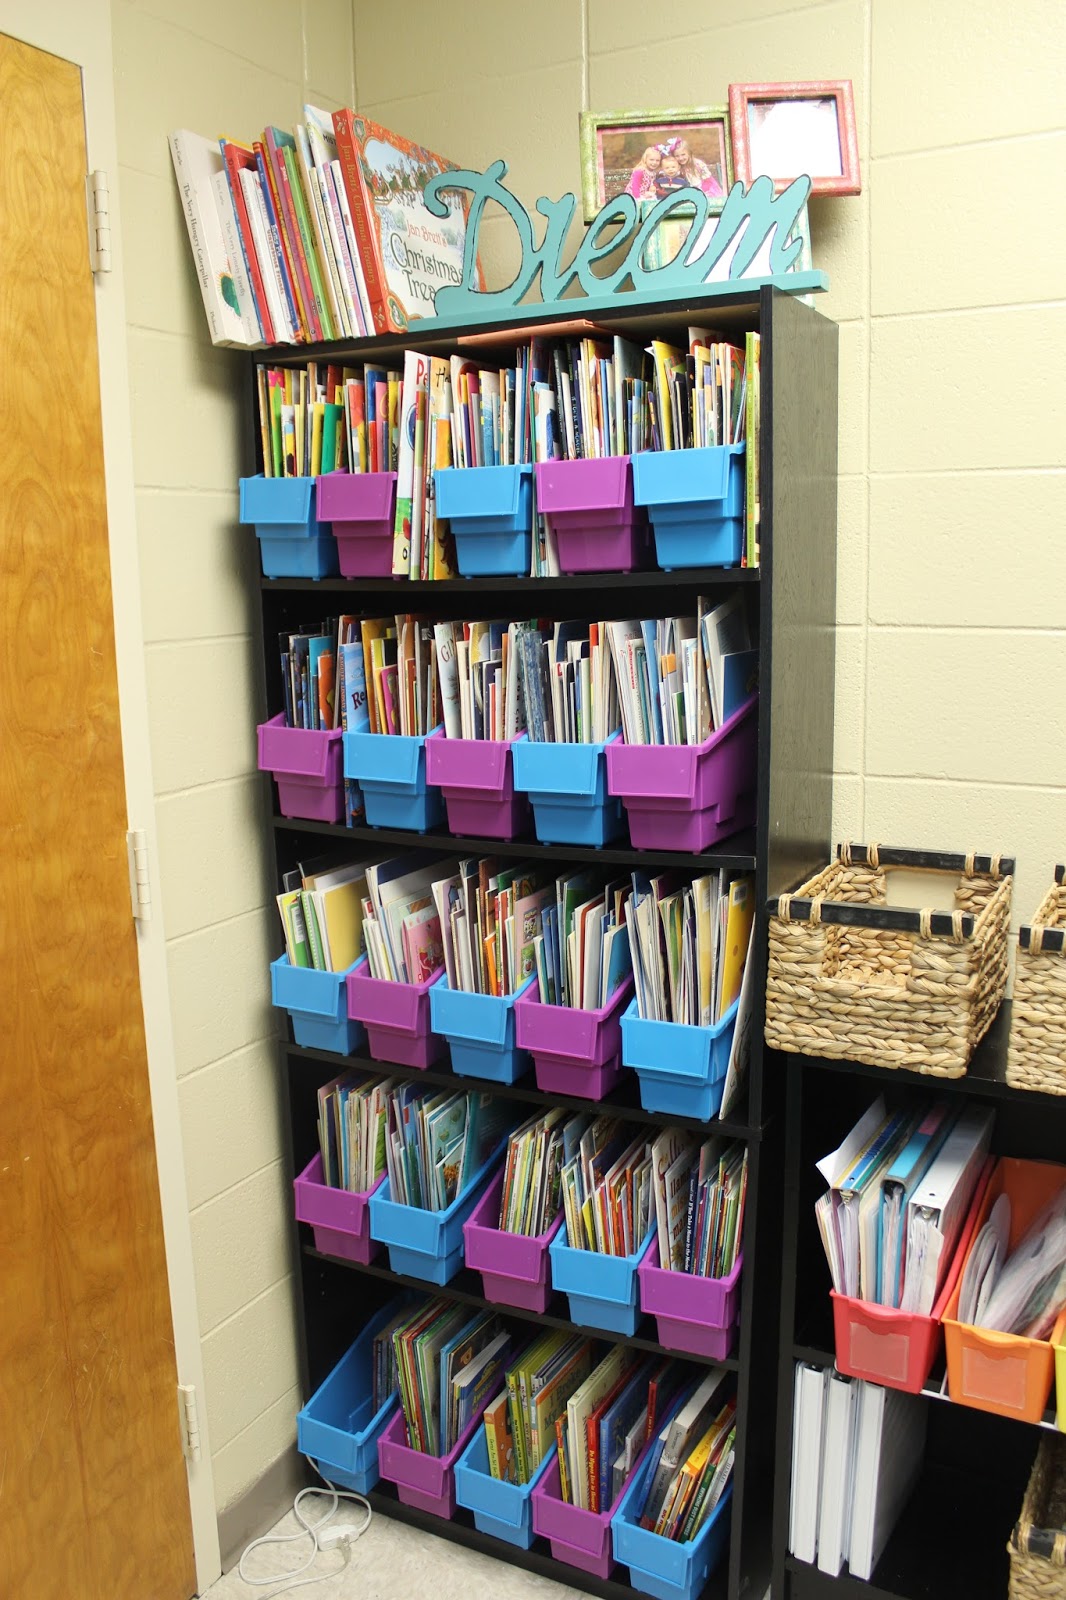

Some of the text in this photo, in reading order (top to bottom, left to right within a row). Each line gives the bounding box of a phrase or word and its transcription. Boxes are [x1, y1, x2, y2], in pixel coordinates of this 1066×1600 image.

[323, 198, 333, 222] Seahorse
[340, 143, 376, 285] Jan Brett's Christmas Treasury
[182, 182, 210, 289] The Very Hungry Caterpillar
[224, 220, 232, 234] The
[406, 220, 447, 248] Jan Brett's
[423, 159, 812, 306] Dream
[269, 223, 283, 257] Enemy Pie
[230, 251, 241, 274] Lonely
[265, 228, 279, 268] Gingerbread
[274, 270, 285, 294] Friends
[390, 232, 464, 285] Christmas
[235, 275, 246, 297] Firefly
[588, 1449, 594, 1457] Do
[719, 1461, 731, 1483] HENKES
[689, 1506, 698, 1518] DUST
[683, 1516, 694, 1536] BUNNIES
